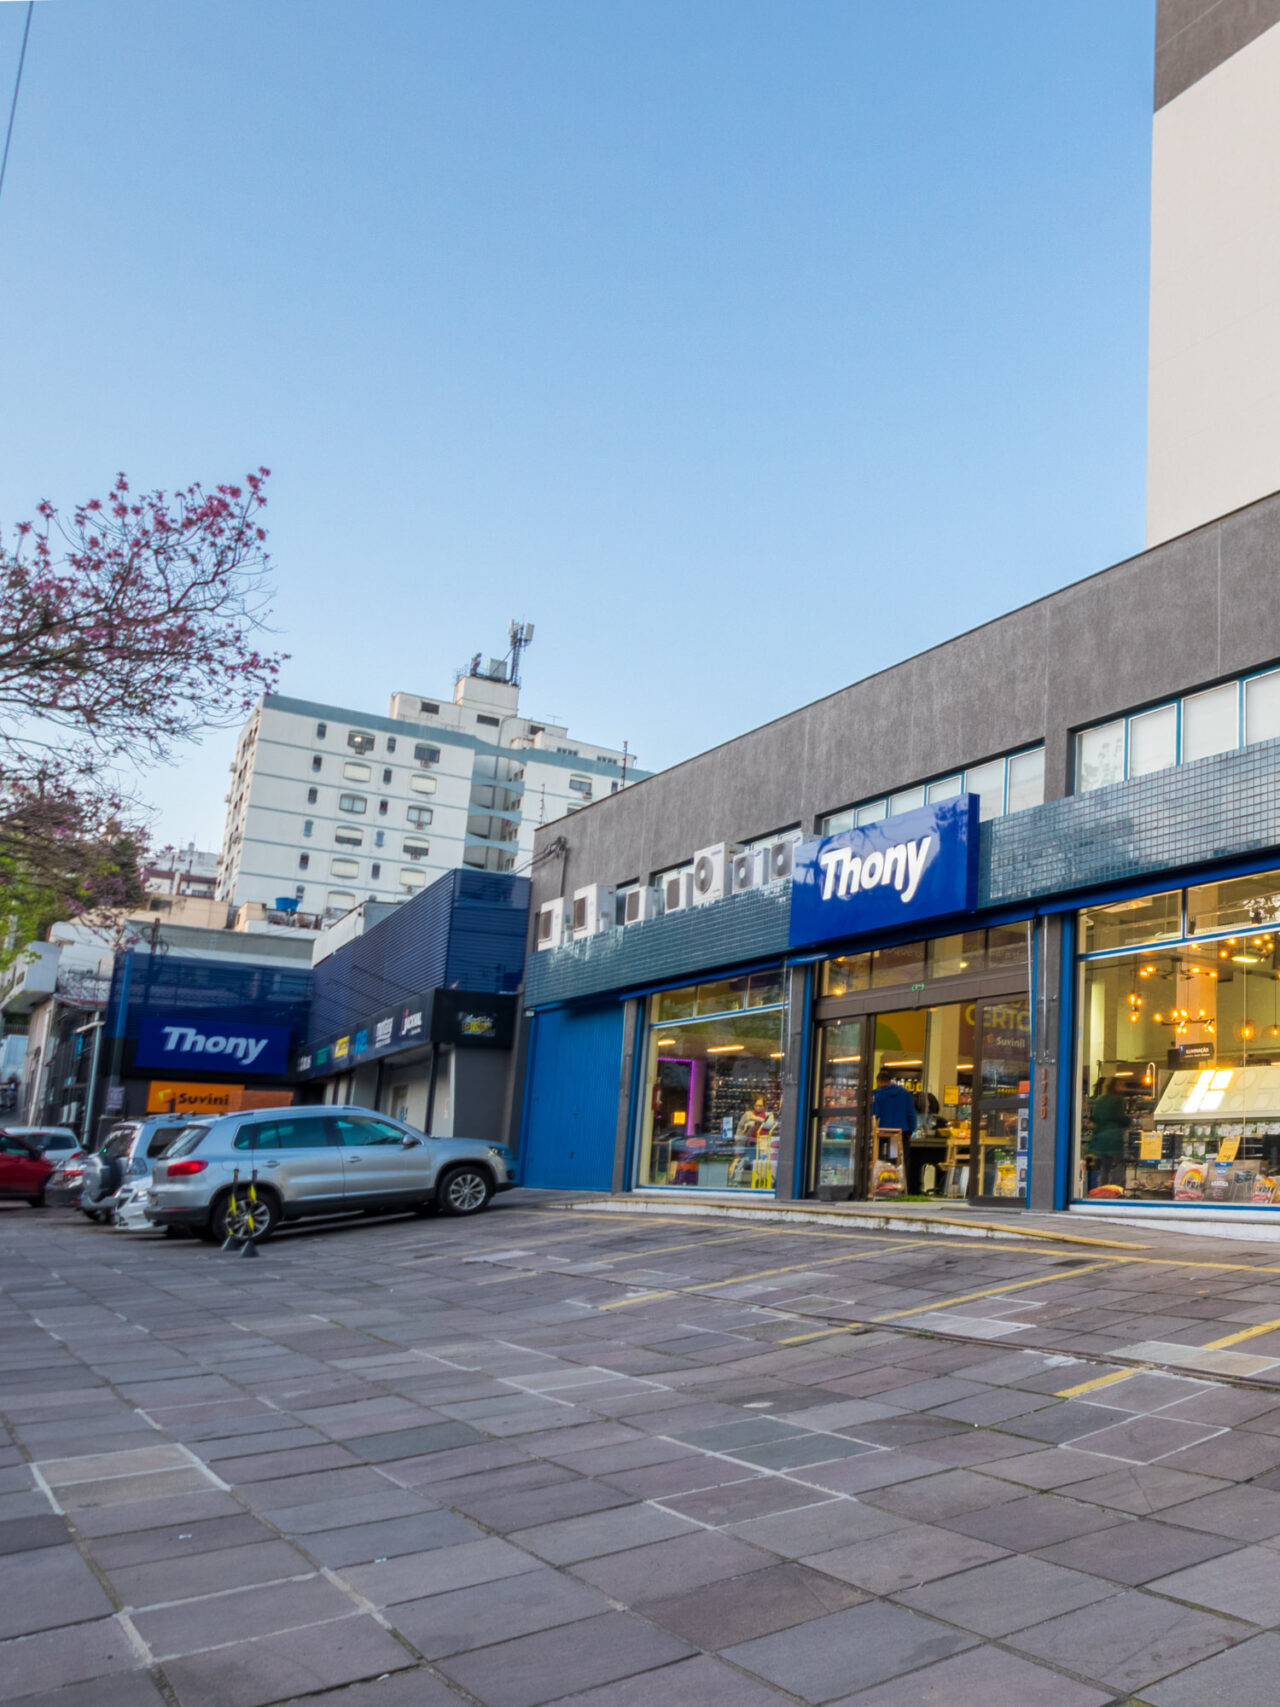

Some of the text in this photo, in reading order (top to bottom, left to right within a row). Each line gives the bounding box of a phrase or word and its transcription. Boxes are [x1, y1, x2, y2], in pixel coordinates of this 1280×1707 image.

[820, 836, 932, 903] Thony
[162, 1026, 269, 1065] Thony
[996, 1036, 1026, 1049] Suvinil
